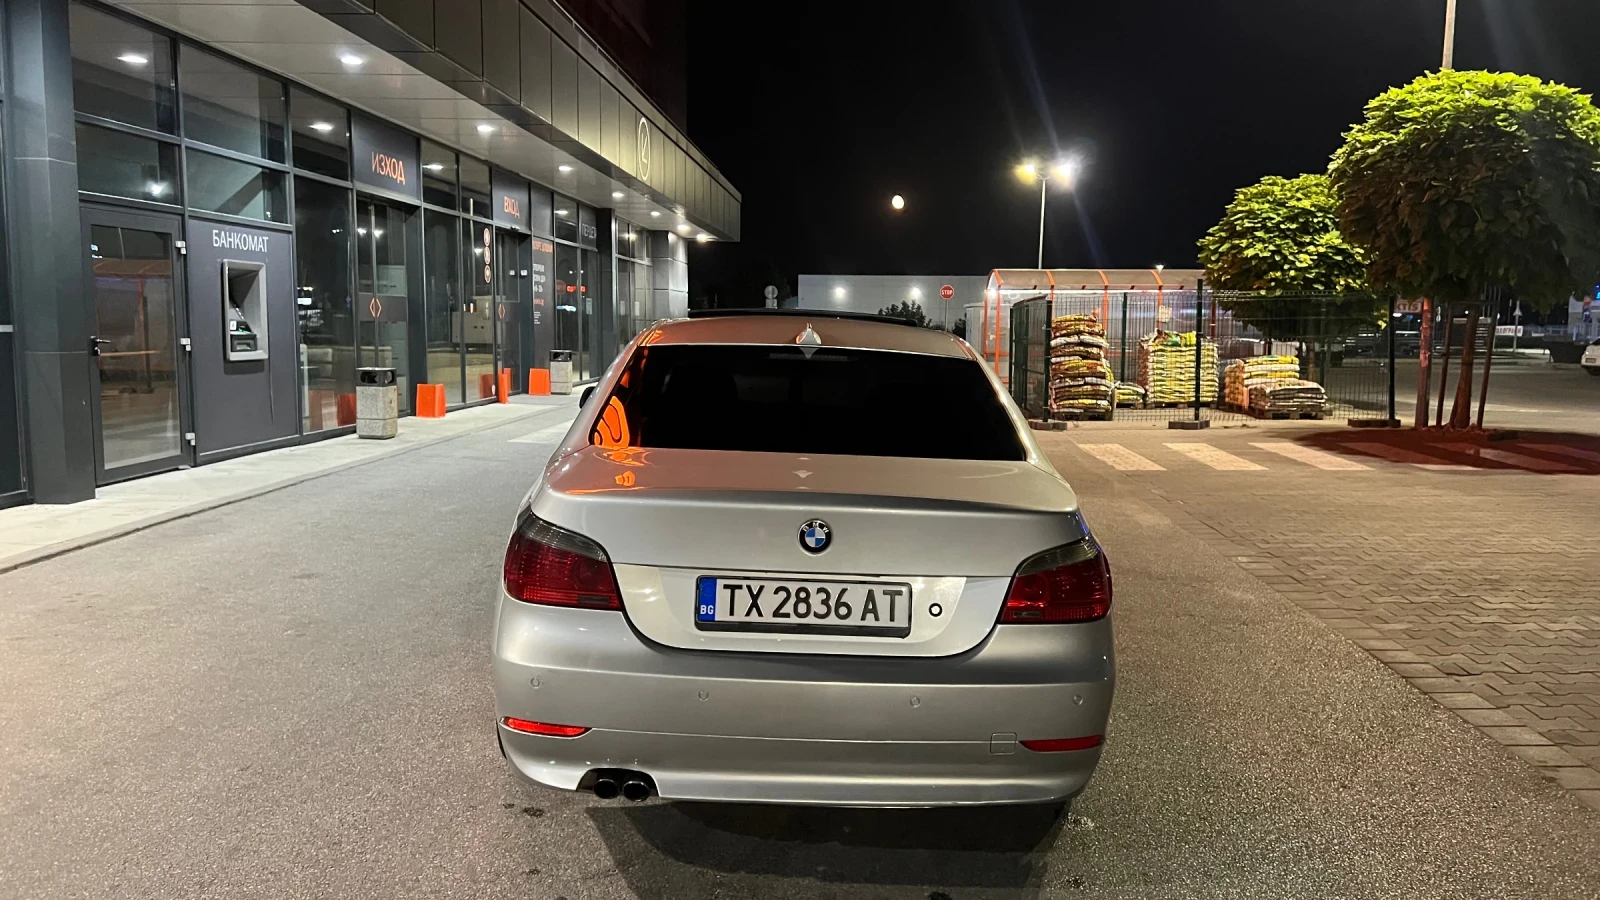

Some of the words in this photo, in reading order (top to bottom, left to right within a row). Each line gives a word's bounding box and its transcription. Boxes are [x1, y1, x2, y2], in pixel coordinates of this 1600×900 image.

[371, 151, 406, 186] ИЗХОД
[504, 195, 520, 219] ВХОД
[212, 229, 269, 253] БАНКОМАТ
[802, 521, 830, 533] BMW
[700, 604, 714, 615] BG
[723, 584, 765, 617] TX
[772, 585, 852, 620] 2836
[860, 588, 904, 622] AT
